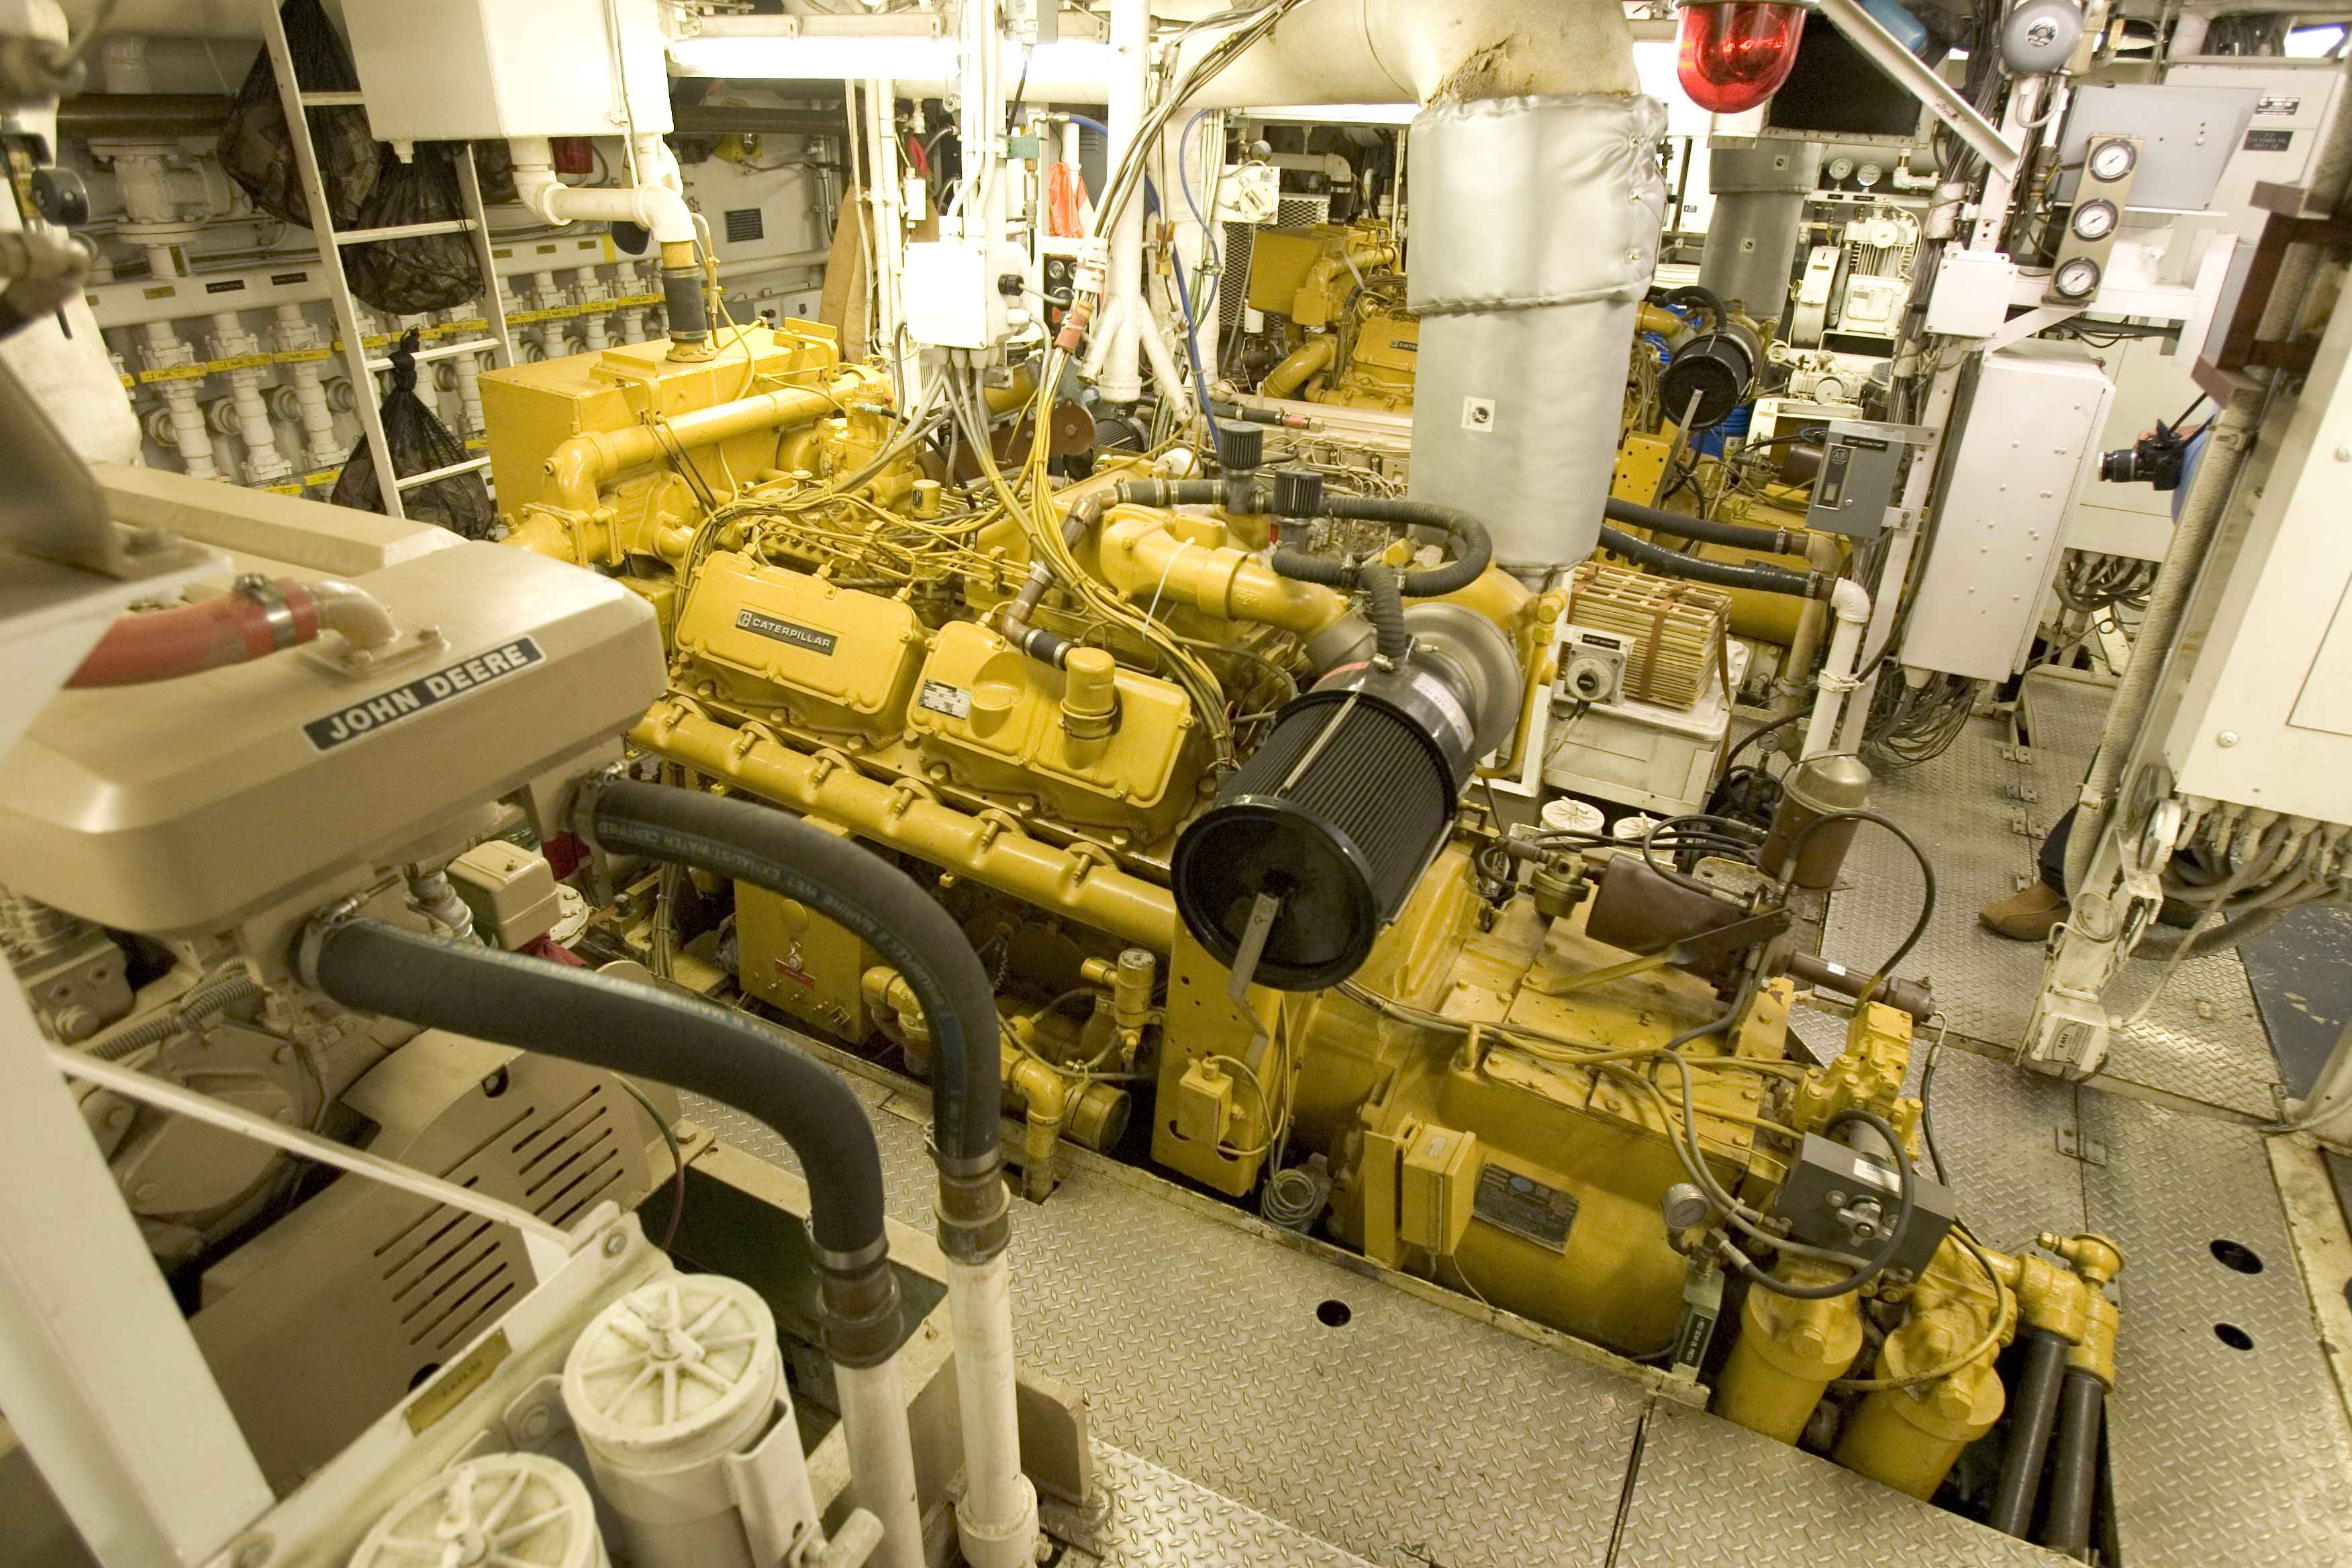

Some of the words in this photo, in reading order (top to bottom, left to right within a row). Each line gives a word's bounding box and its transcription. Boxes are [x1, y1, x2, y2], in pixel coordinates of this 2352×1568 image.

[752, 618, 831, 648] CATERPILLAR
[330, 687, 422, 740] JOHN
[424, 644, 529, 699] DEERE
[595, 820, 660, 843] CERTIFIED
[2059, 1034, 2069, 1048] EMI
